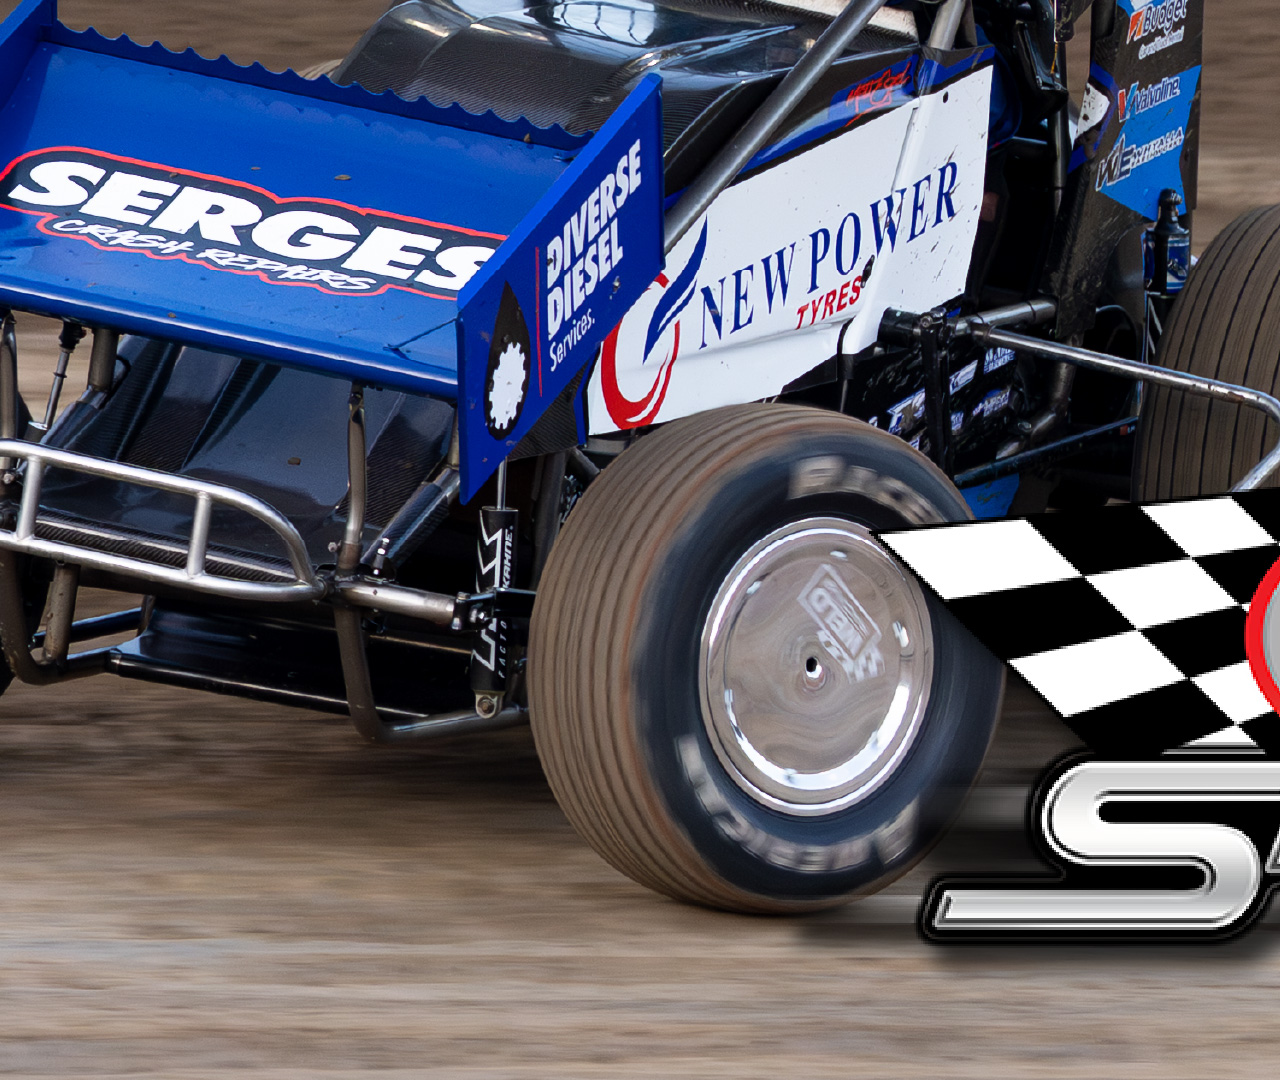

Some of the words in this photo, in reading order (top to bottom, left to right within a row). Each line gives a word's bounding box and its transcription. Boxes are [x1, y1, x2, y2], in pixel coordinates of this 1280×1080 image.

[8, 160, 499, 292] SERGES
[53, 219, 194, 253] CRASH
[196, 248, 376, 290] REPAIRS
[546, 138, 642, 283] DIVERSE
[699, 241, 797, 350] NEW
[807, 161, 959, 294] POWER
[546, 219, 624, 341] DIESEL
[796, 274, 863, 331] TYRES
